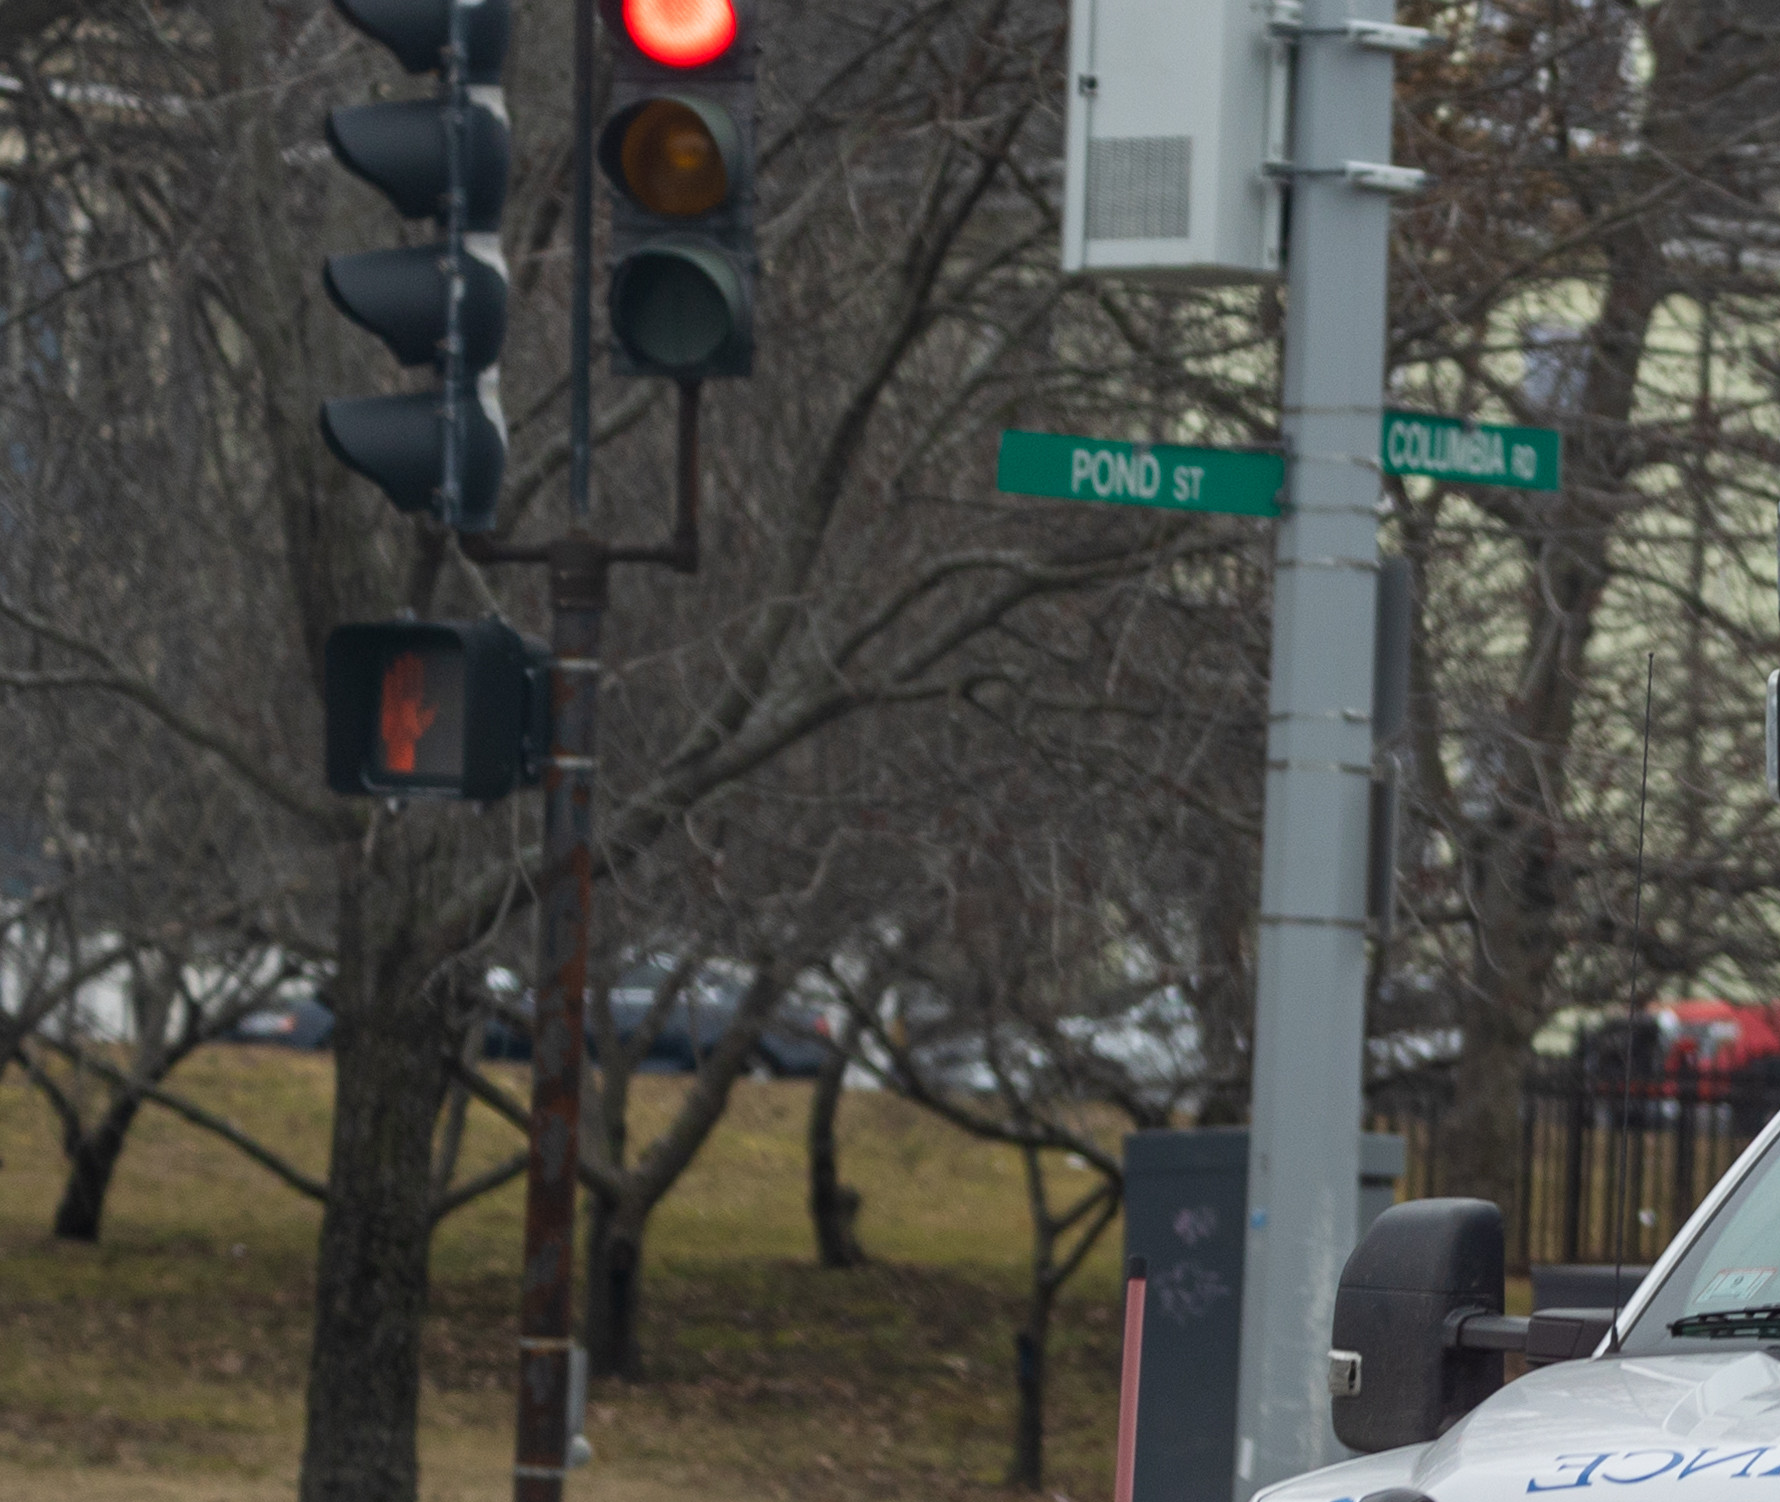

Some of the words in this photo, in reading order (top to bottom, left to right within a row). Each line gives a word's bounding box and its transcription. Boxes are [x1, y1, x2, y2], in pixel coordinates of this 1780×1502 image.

[1071, 448, 1160, 500] POND
[1173, 466, 1205, 502] ST
[1387, 421, 1507, 475] COLUMBIA
[1511, 446, 1537, 480] RD
